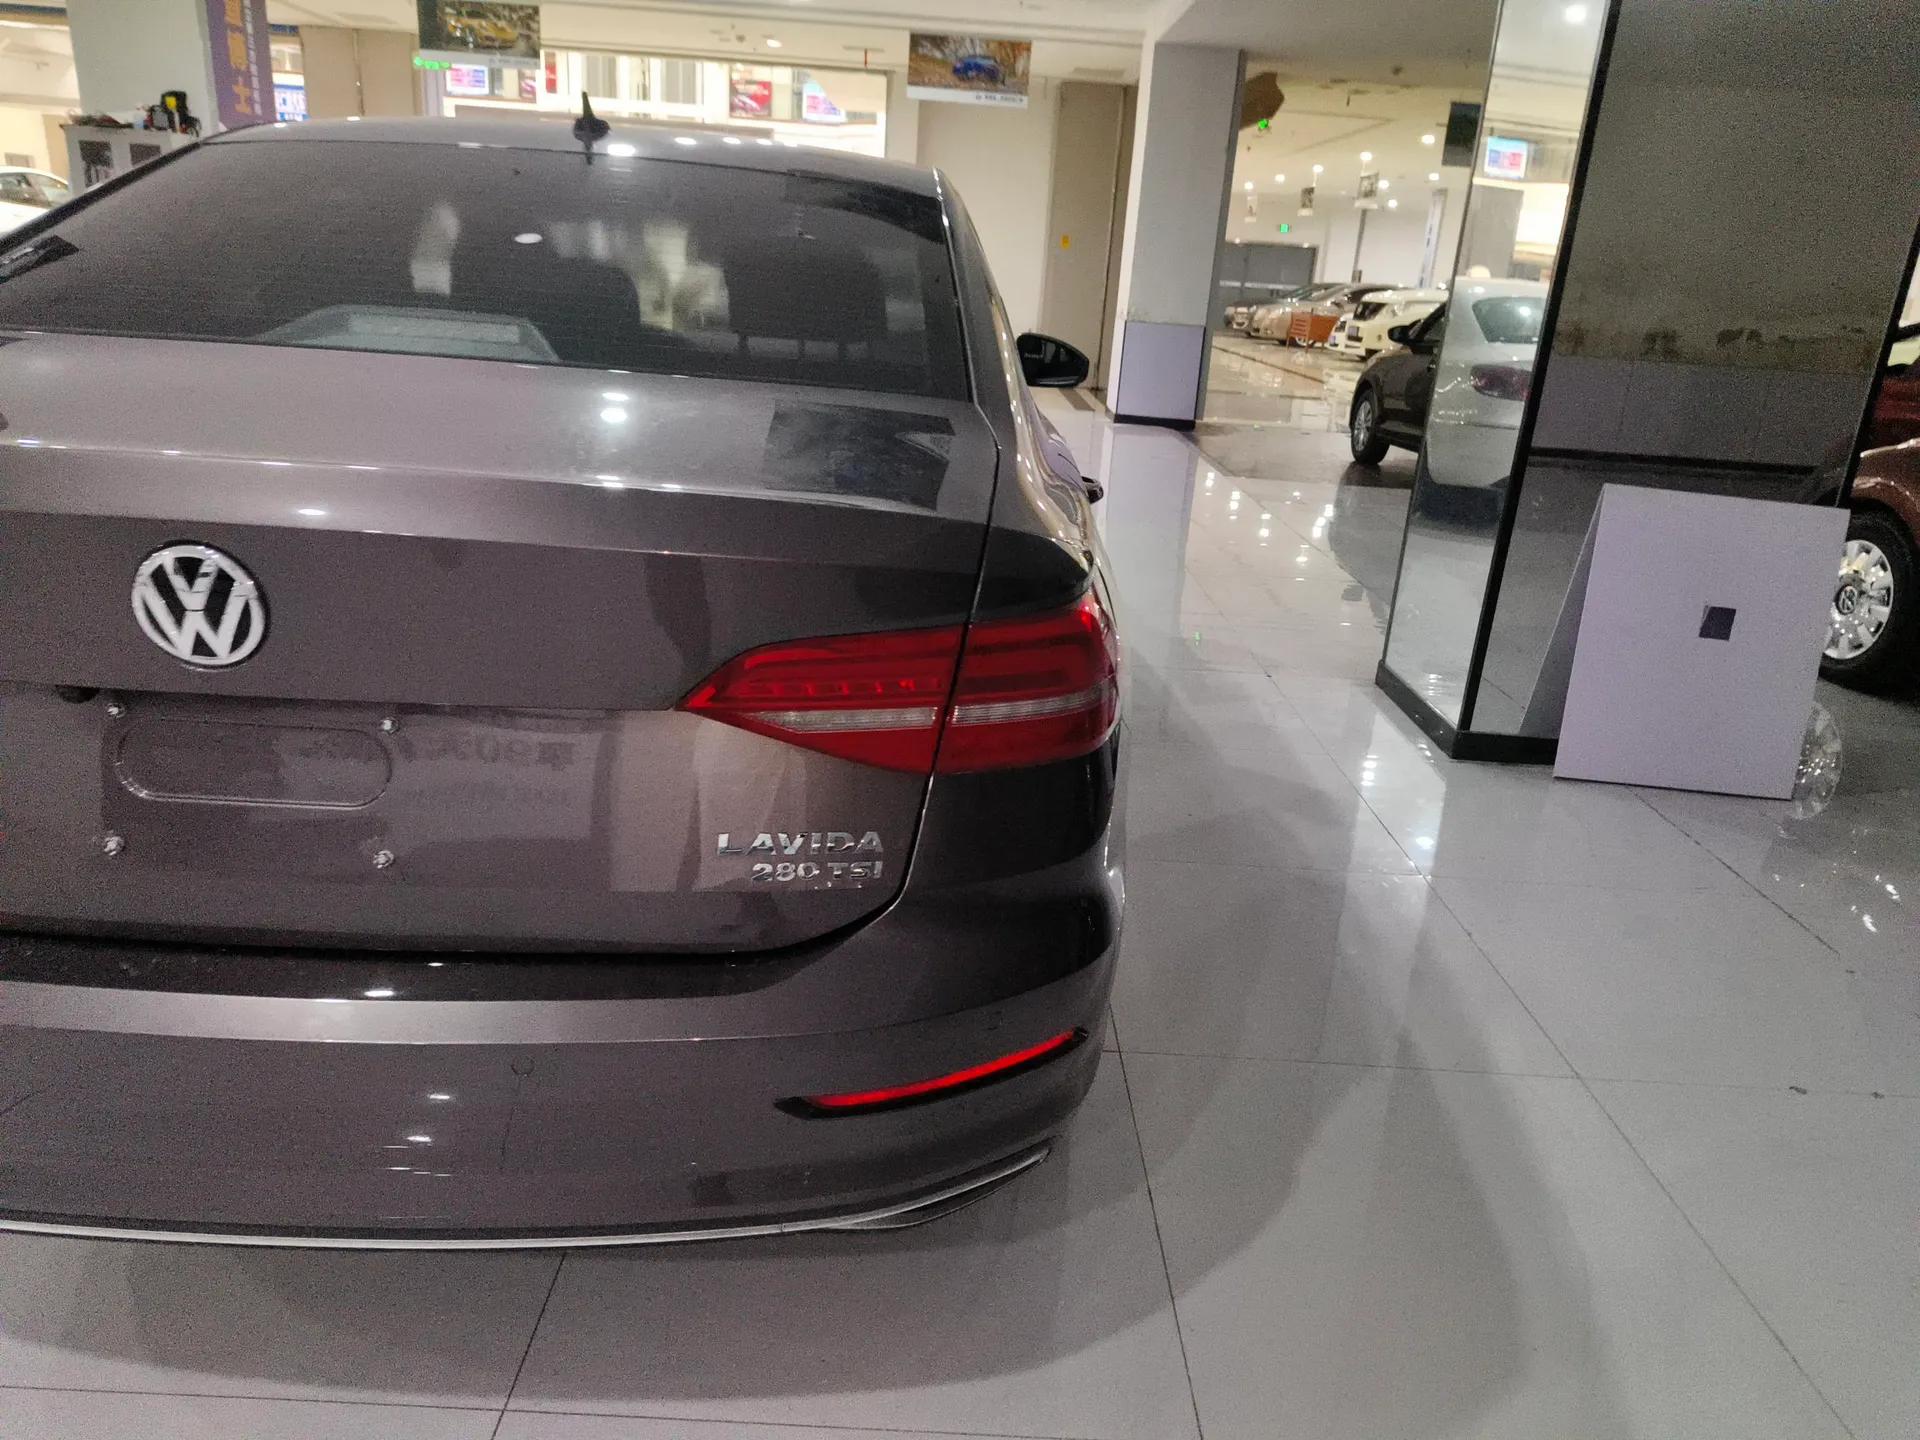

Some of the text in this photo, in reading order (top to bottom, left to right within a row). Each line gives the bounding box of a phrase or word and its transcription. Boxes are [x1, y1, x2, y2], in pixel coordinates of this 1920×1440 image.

[717, 831, 884, 855] LAVIDA
[752, 861, 883, 881] 280 TSI
